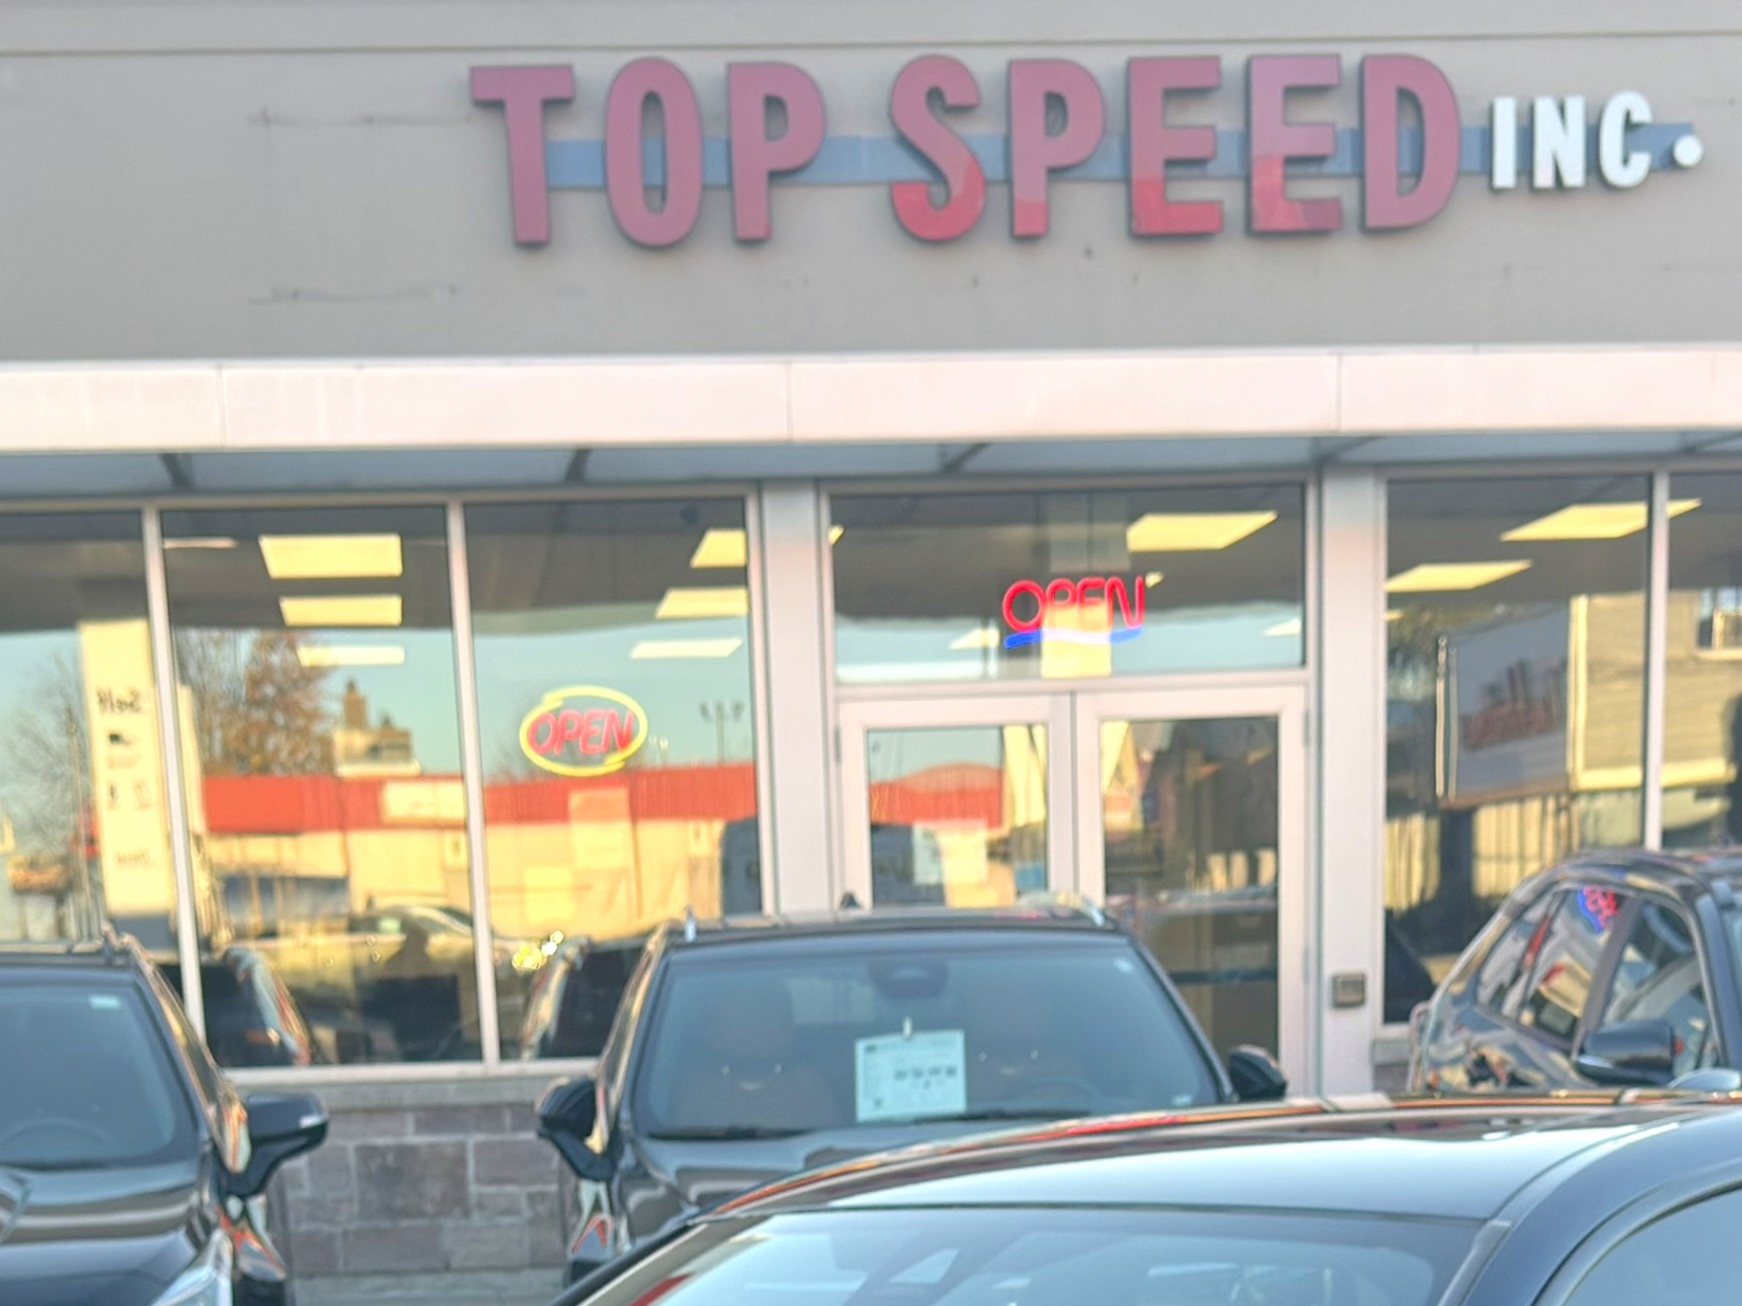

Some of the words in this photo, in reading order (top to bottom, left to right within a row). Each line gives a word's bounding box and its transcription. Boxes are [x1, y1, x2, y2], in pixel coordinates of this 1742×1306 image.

[468, 56, 828, 248] TOP
[886, 52, 1460, 243] SPEED
[1490, 90, 1704, 190] INC.
[999, 576, 1145, 632] OPEN
[527, 708, 635, 756] OPEN
